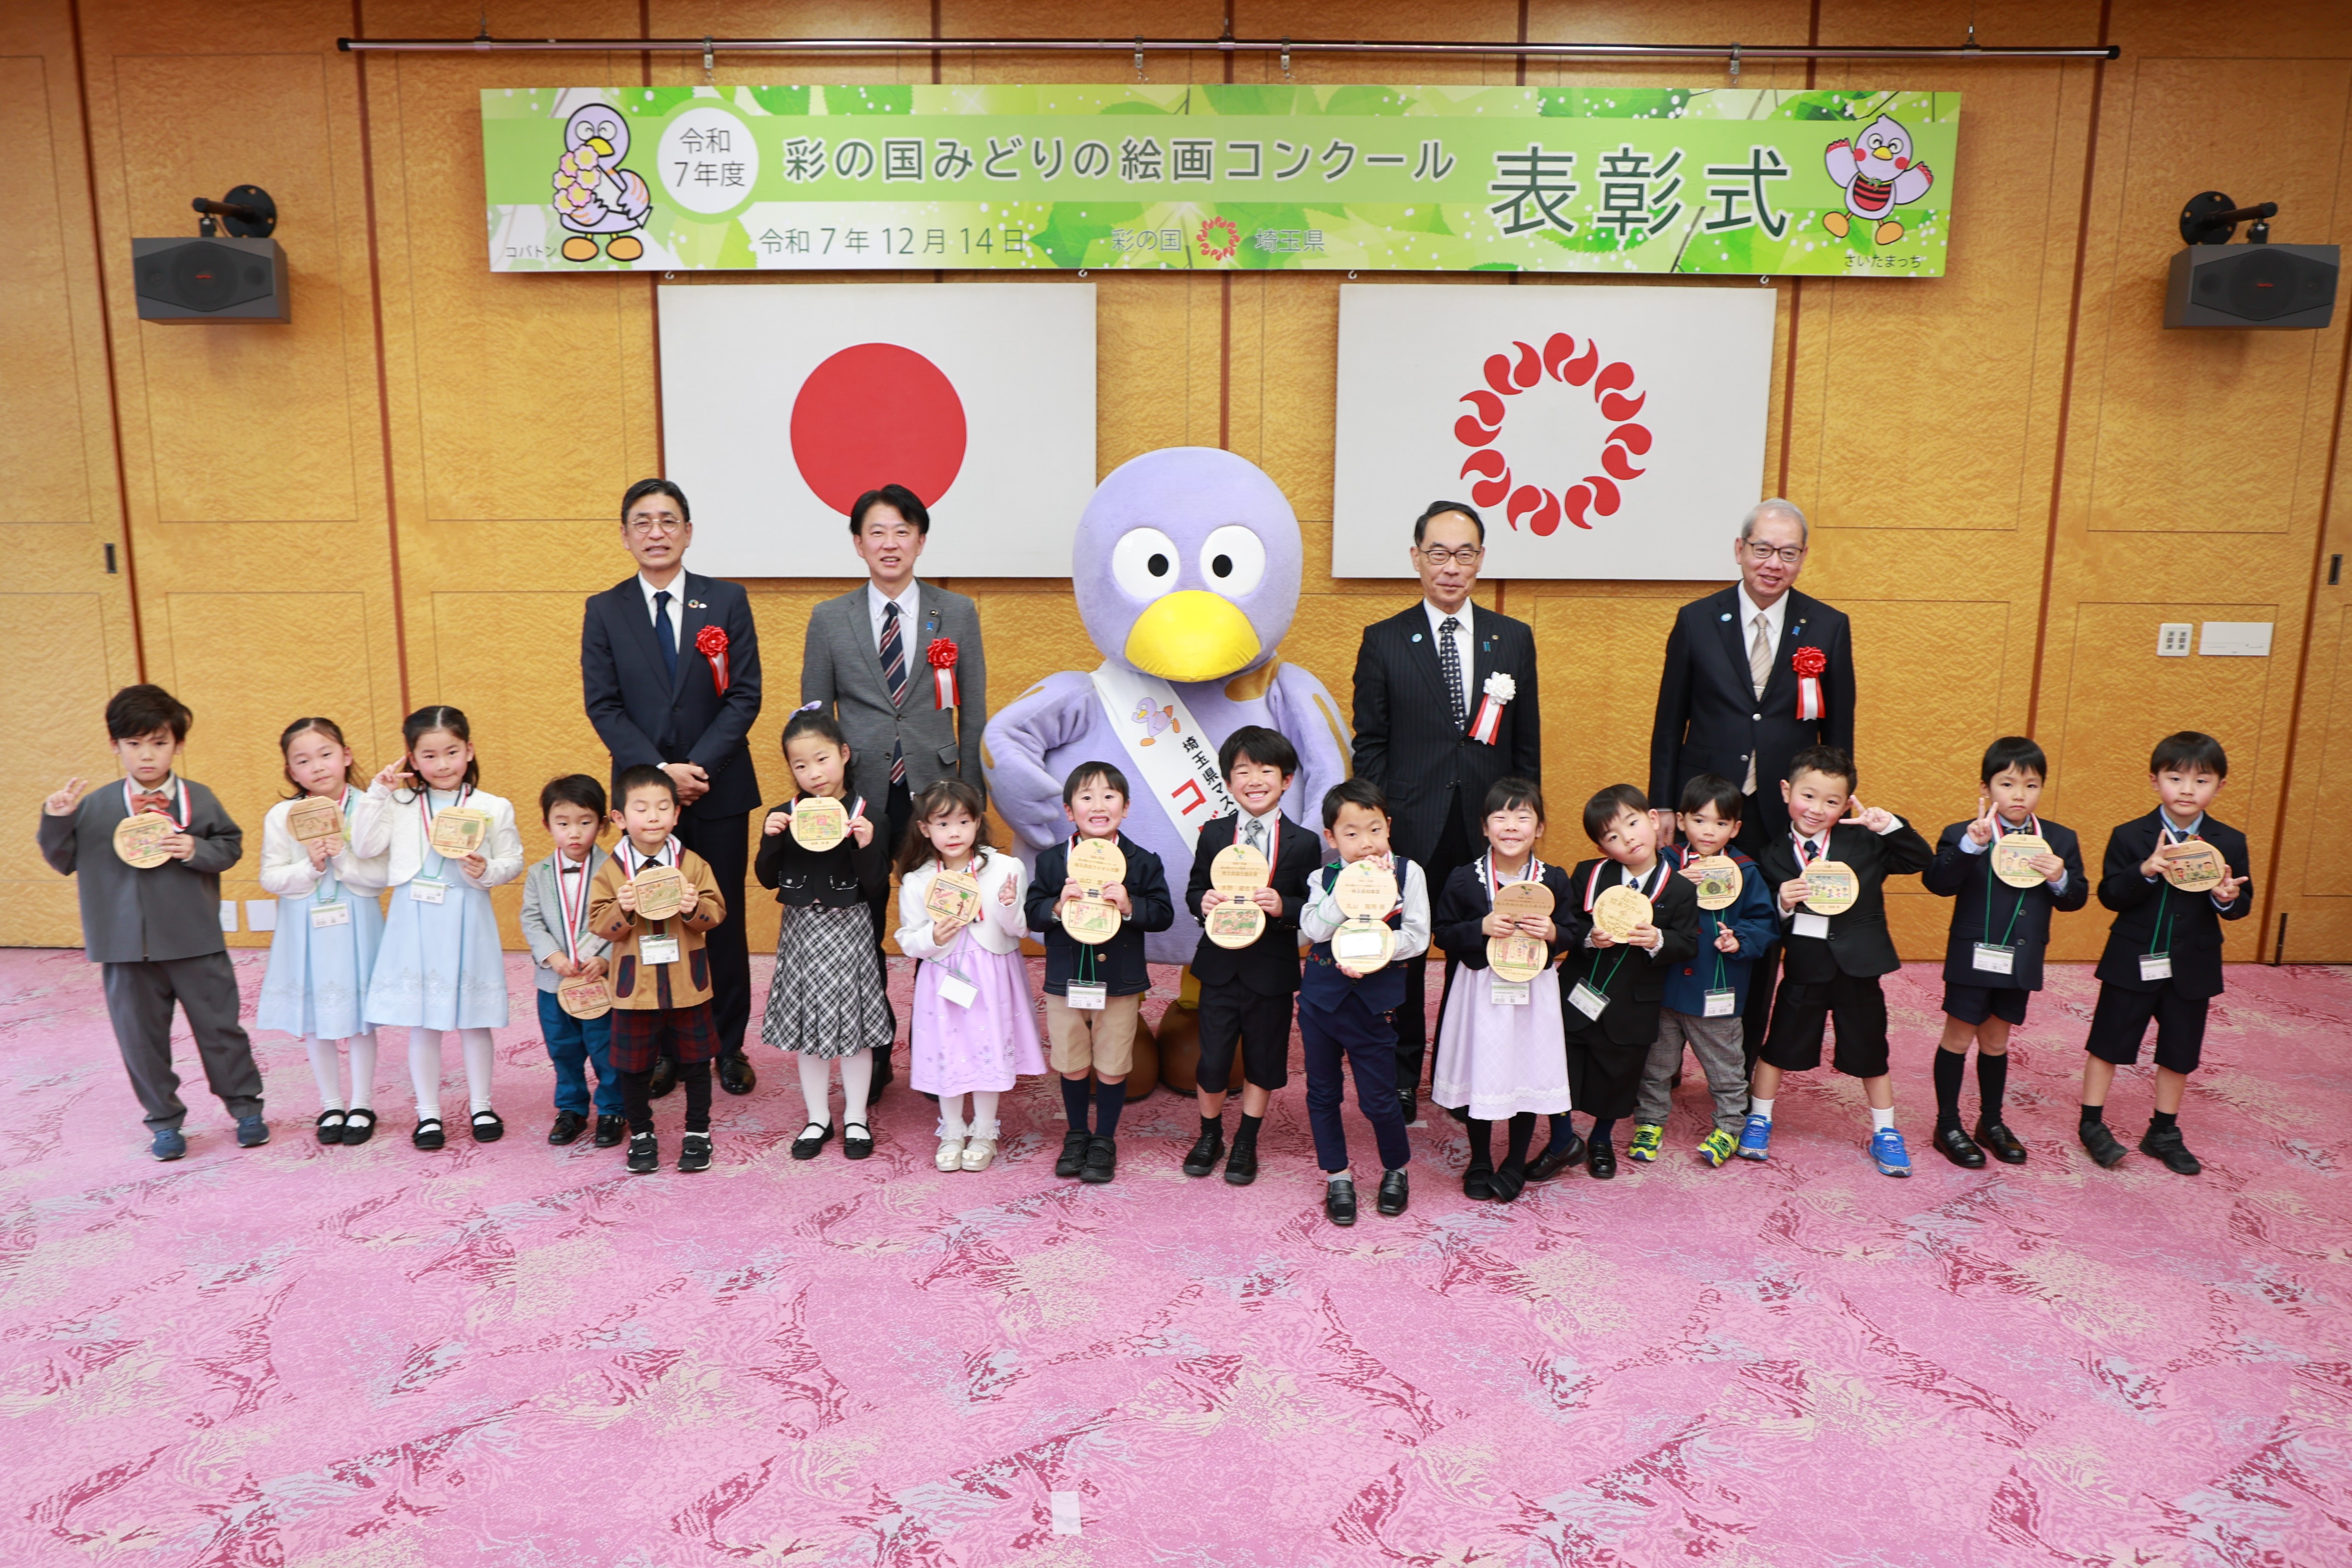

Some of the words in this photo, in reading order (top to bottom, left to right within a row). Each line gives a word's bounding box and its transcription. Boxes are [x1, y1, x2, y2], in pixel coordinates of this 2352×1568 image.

[679, 127, 731, 154] 令和
[785, 136, 1454, 183] 彩の国みどりの絵画コンクール
[674, 161, 746, 187] 7年度
[1491, 147, 1789, 237] 表彰式
[505, 245, 557, 258] コバトン
[1111, 228, 1182, 252] 彩の国
[1254, 229, 1325, 252] 埼玉県
[1844, 254, 1921, 268] さいたまっち
